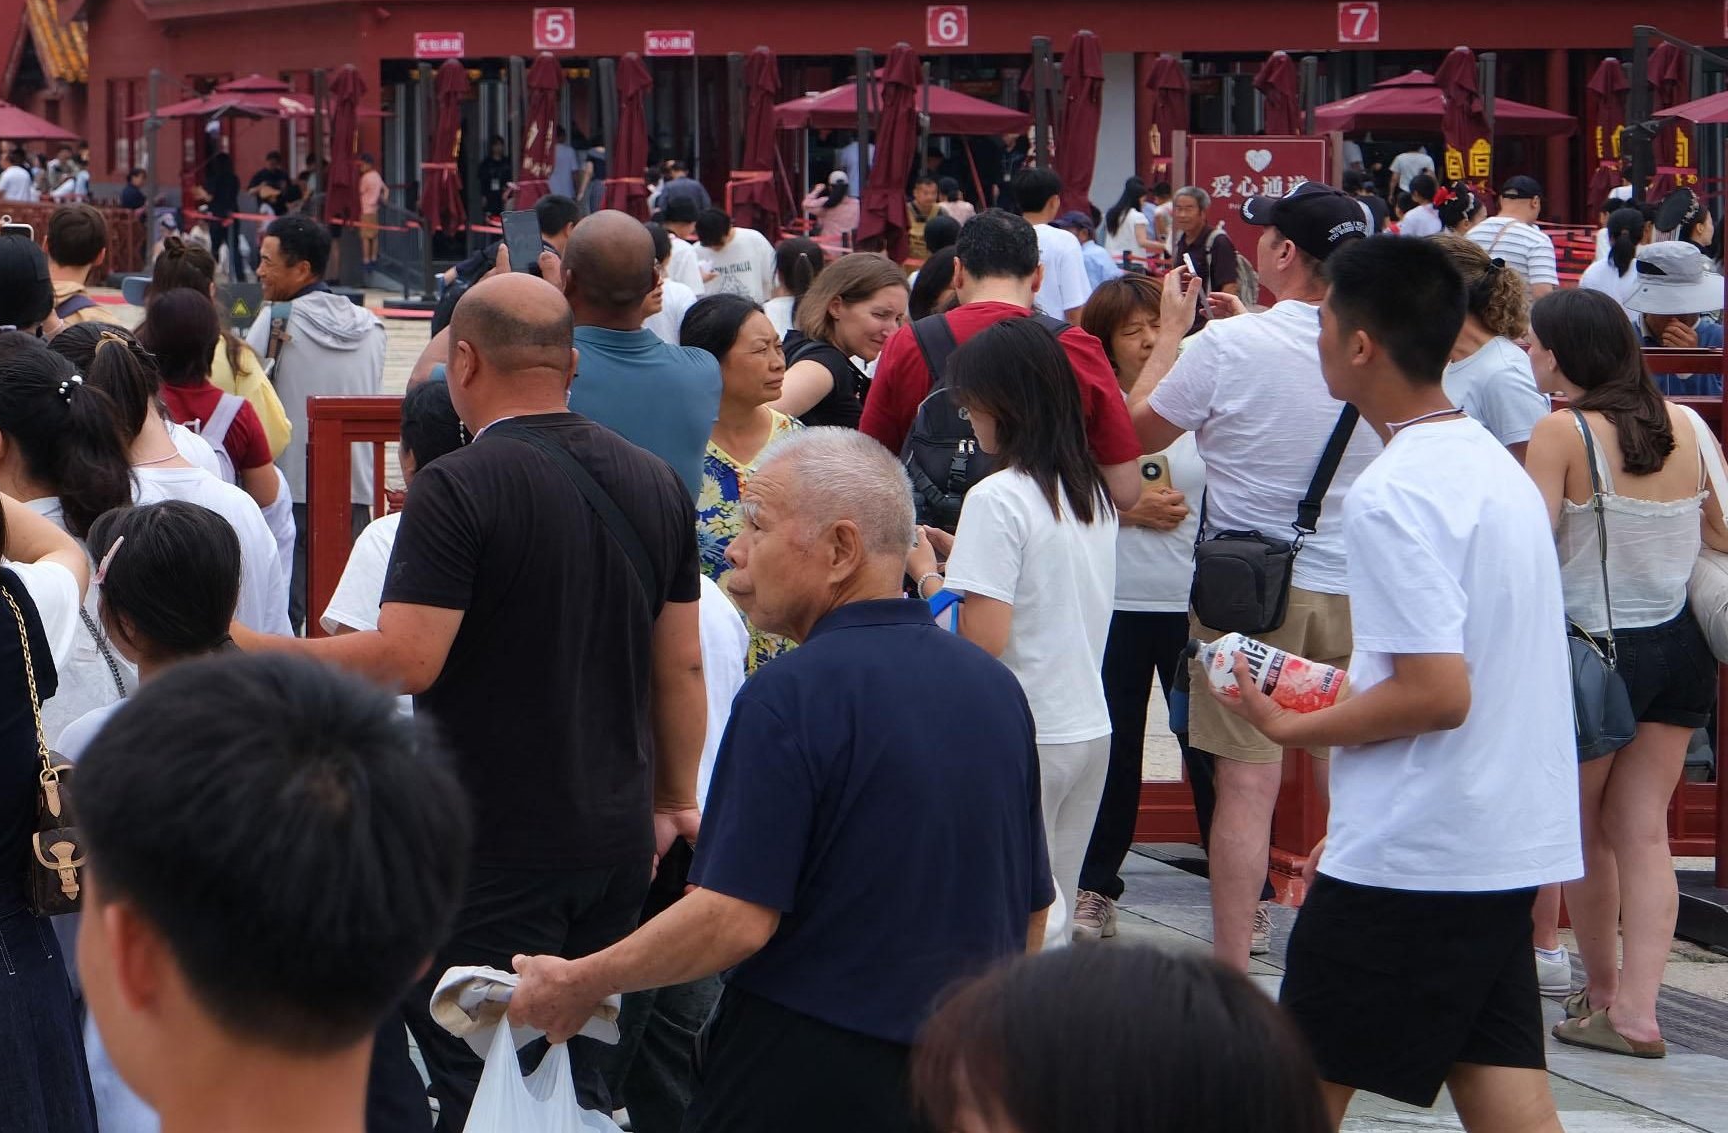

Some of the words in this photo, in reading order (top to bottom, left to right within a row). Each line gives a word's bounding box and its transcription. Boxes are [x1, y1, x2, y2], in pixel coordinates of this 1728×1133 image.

[545, 14, 564, 43] 5
[938, 11, 958, 40] 6
[1350, 8, 1369, 35] 7
